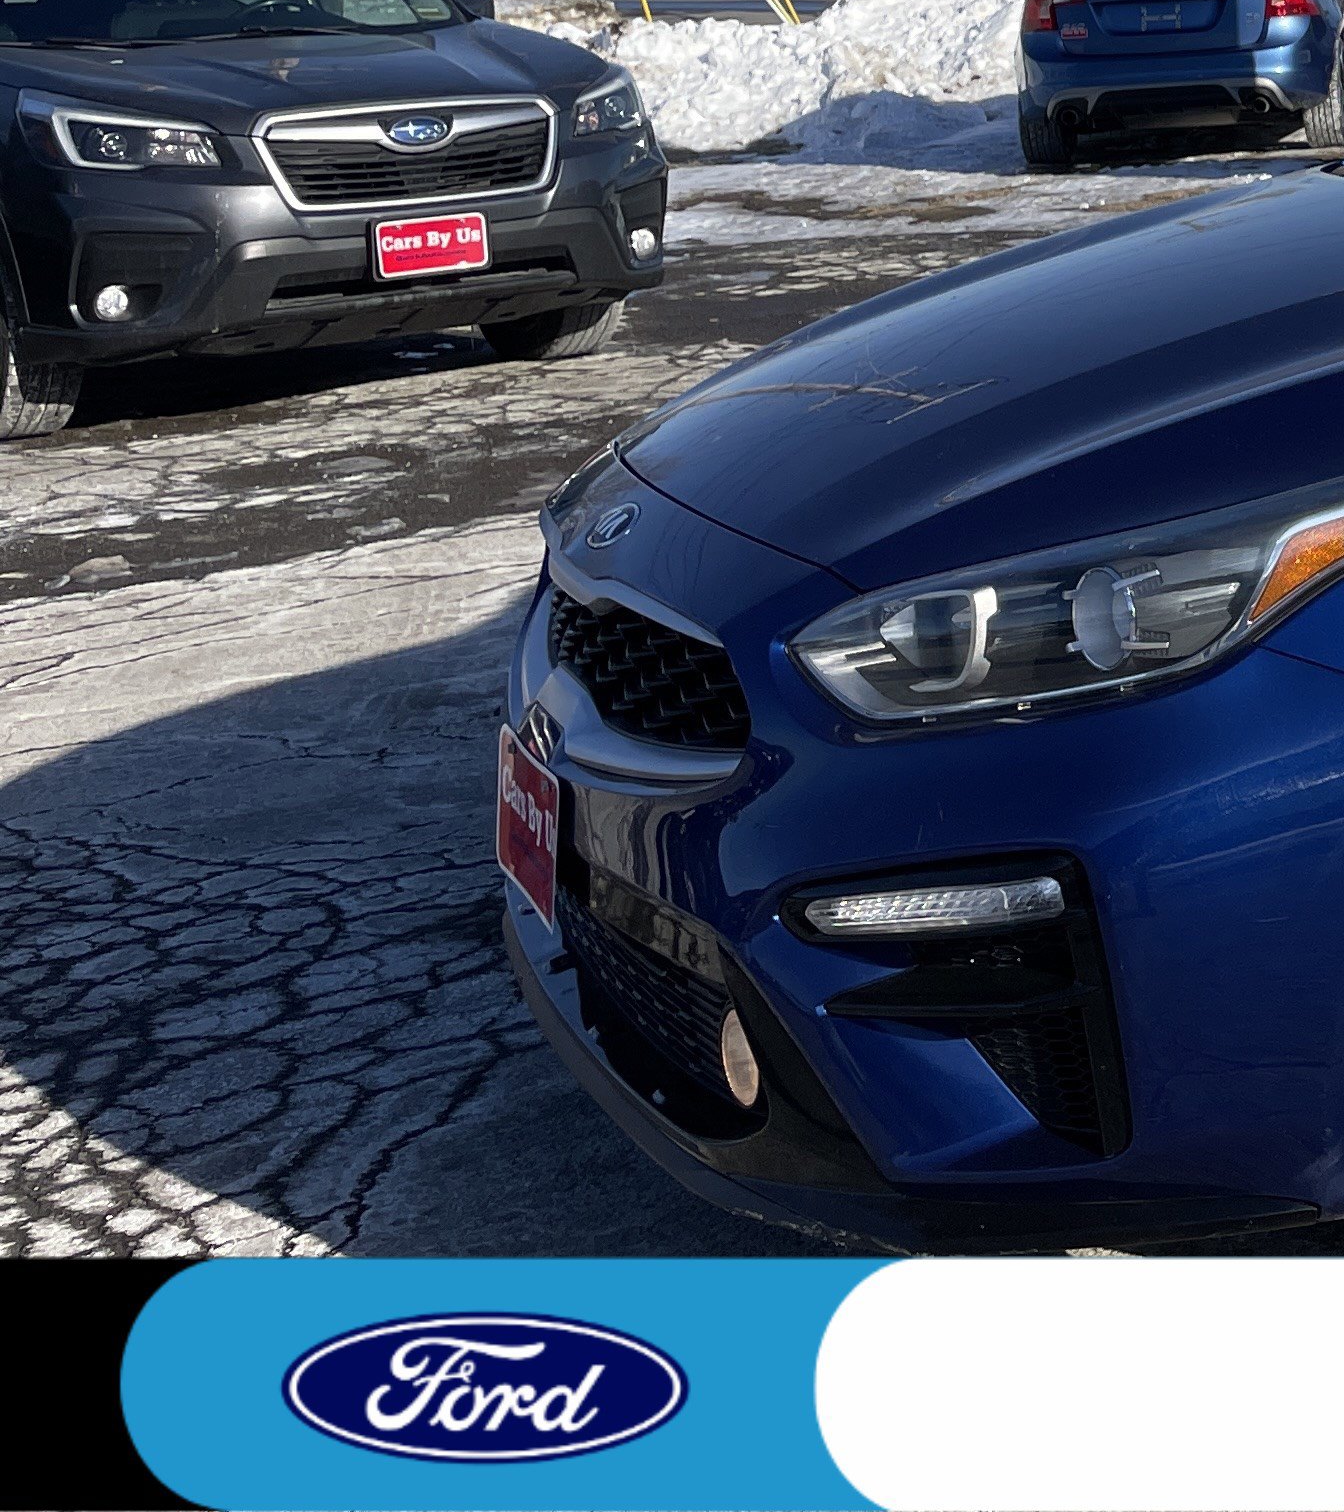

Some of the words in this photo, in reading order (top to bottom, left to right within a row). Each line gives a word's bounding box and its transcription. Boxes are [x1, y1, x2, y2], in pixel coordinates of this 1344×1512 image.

[381, 235, 423, 253] Cars
[426, 230, 452, 249] By
[455, 226, 482, 244] Us
[502, 764, 527, 823] Cars
[527, 791, 543, 848] By
